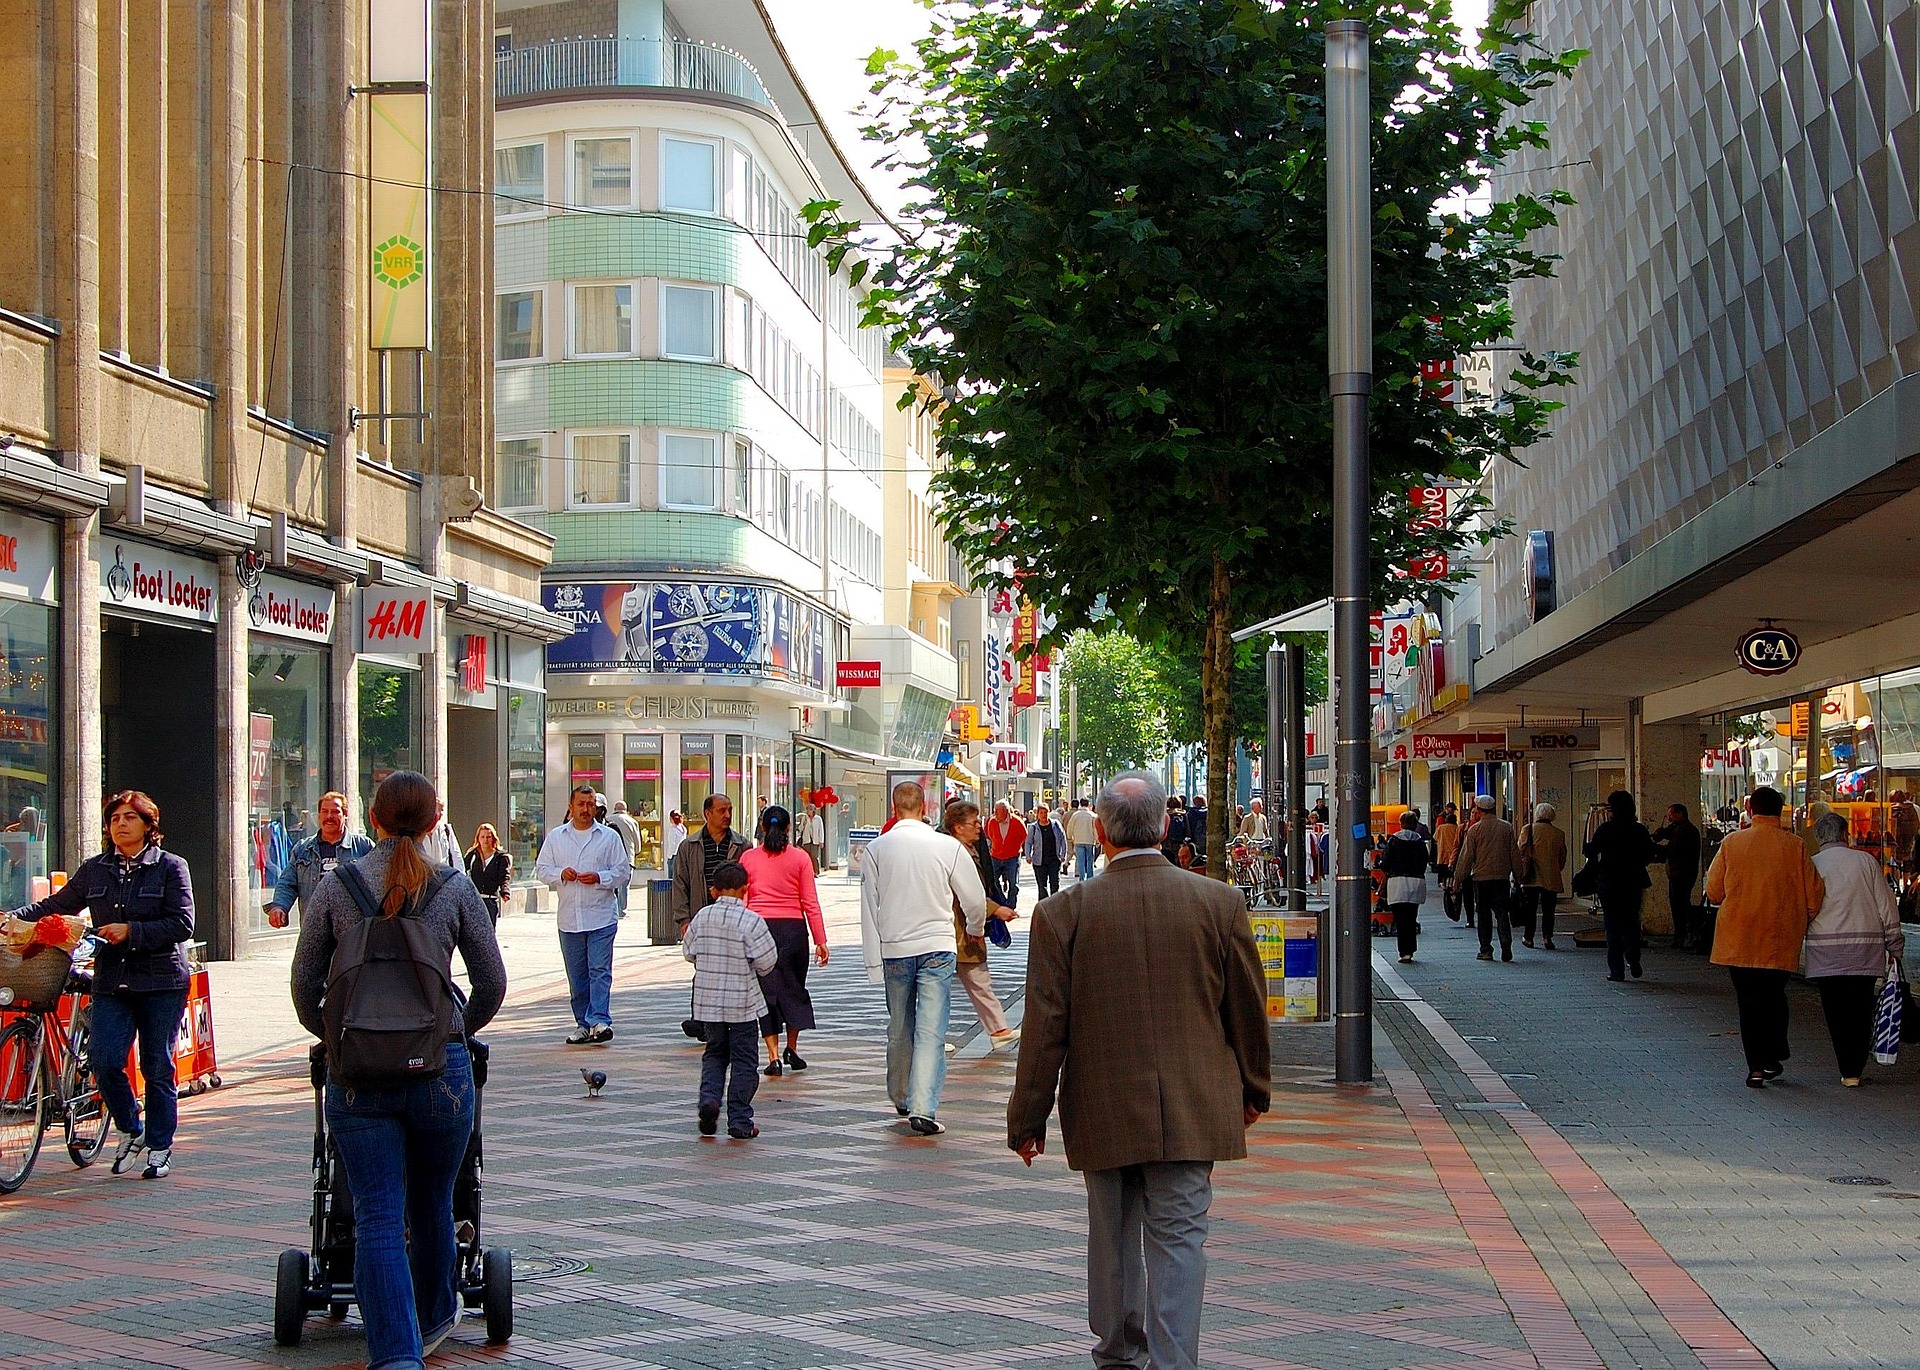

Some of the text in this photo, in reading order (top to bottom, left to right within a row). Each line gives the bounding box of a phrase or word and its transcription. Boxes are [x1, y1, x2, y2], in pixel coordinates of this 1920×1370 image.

[384, 257, 412, 268] VRR
[133, 563, 212, 612] Foot Locker
[268, 592, 329, 635] Foot Locker
[368, 600, 426, 640] H&M
[1749, 639, 1791, 661] C&A
[838, 670, 880, 679] WISSMACH
[624, 695, 711, 719] CHRIST
[1415, 736, 1452, 749] s.Oliver
[1530, 734, 1578, 749] RENO
[252, 751, 266, 777] 70
[1484, 749, 1525, 760] RENO
